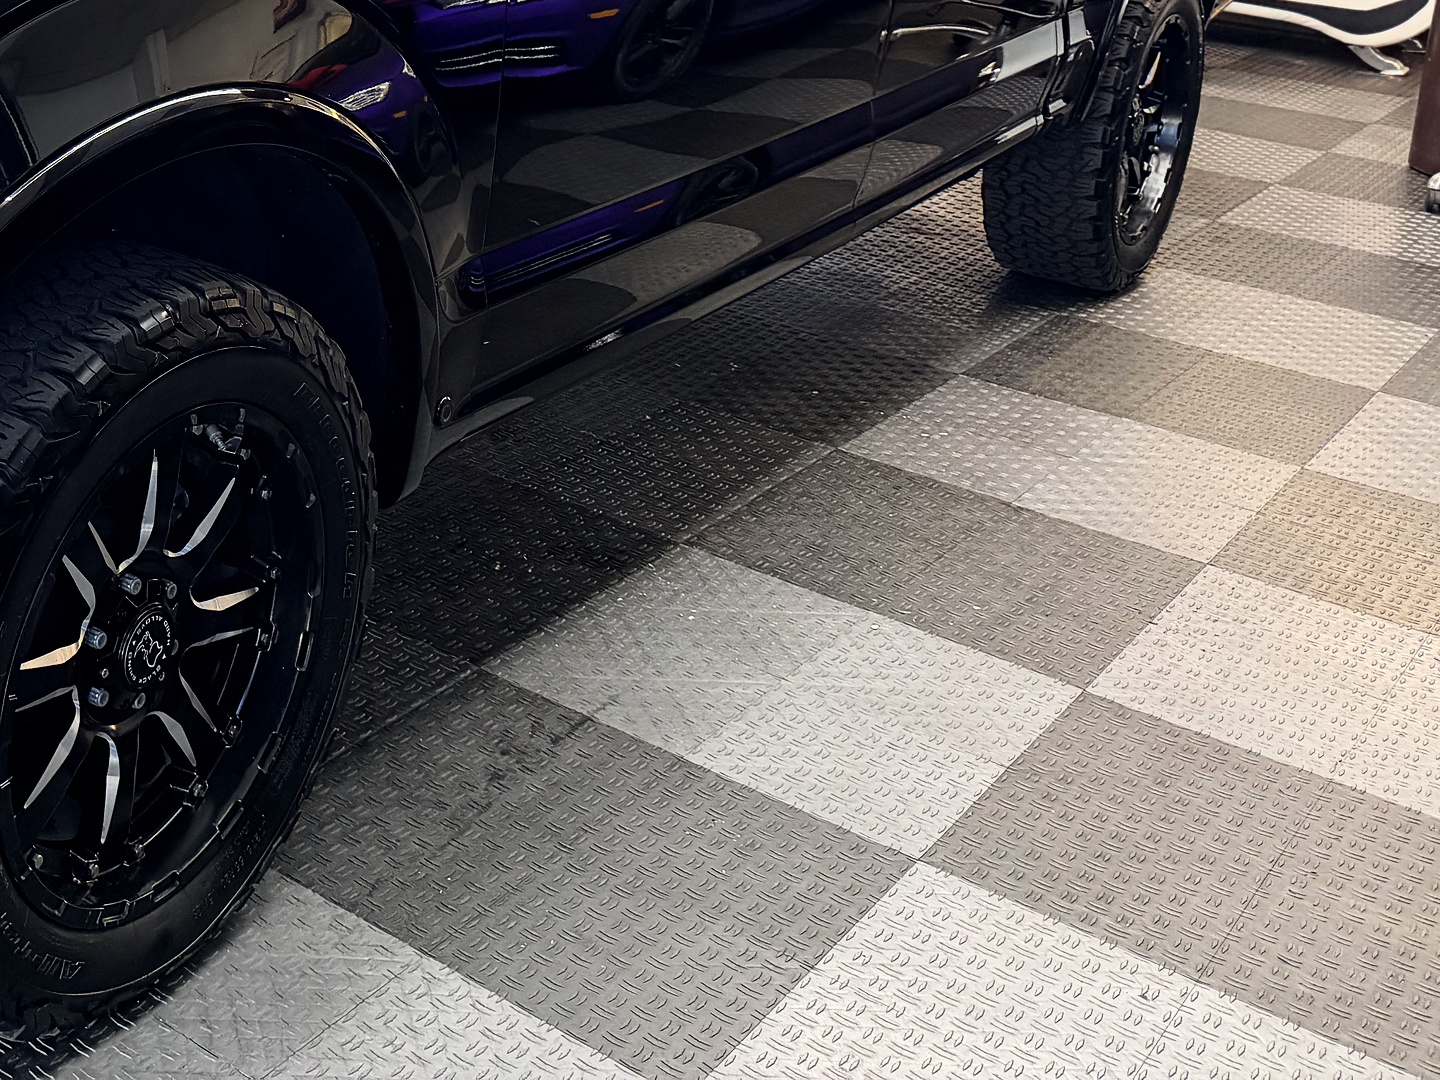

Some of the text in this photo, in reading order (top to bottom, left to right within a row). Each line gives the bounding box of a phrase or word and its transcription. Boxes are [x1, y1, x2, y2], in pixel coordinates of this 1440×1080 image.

[137, 615, 163, 635] ALLOYS
[127, 651, 162, 684] BLACK RHINO
